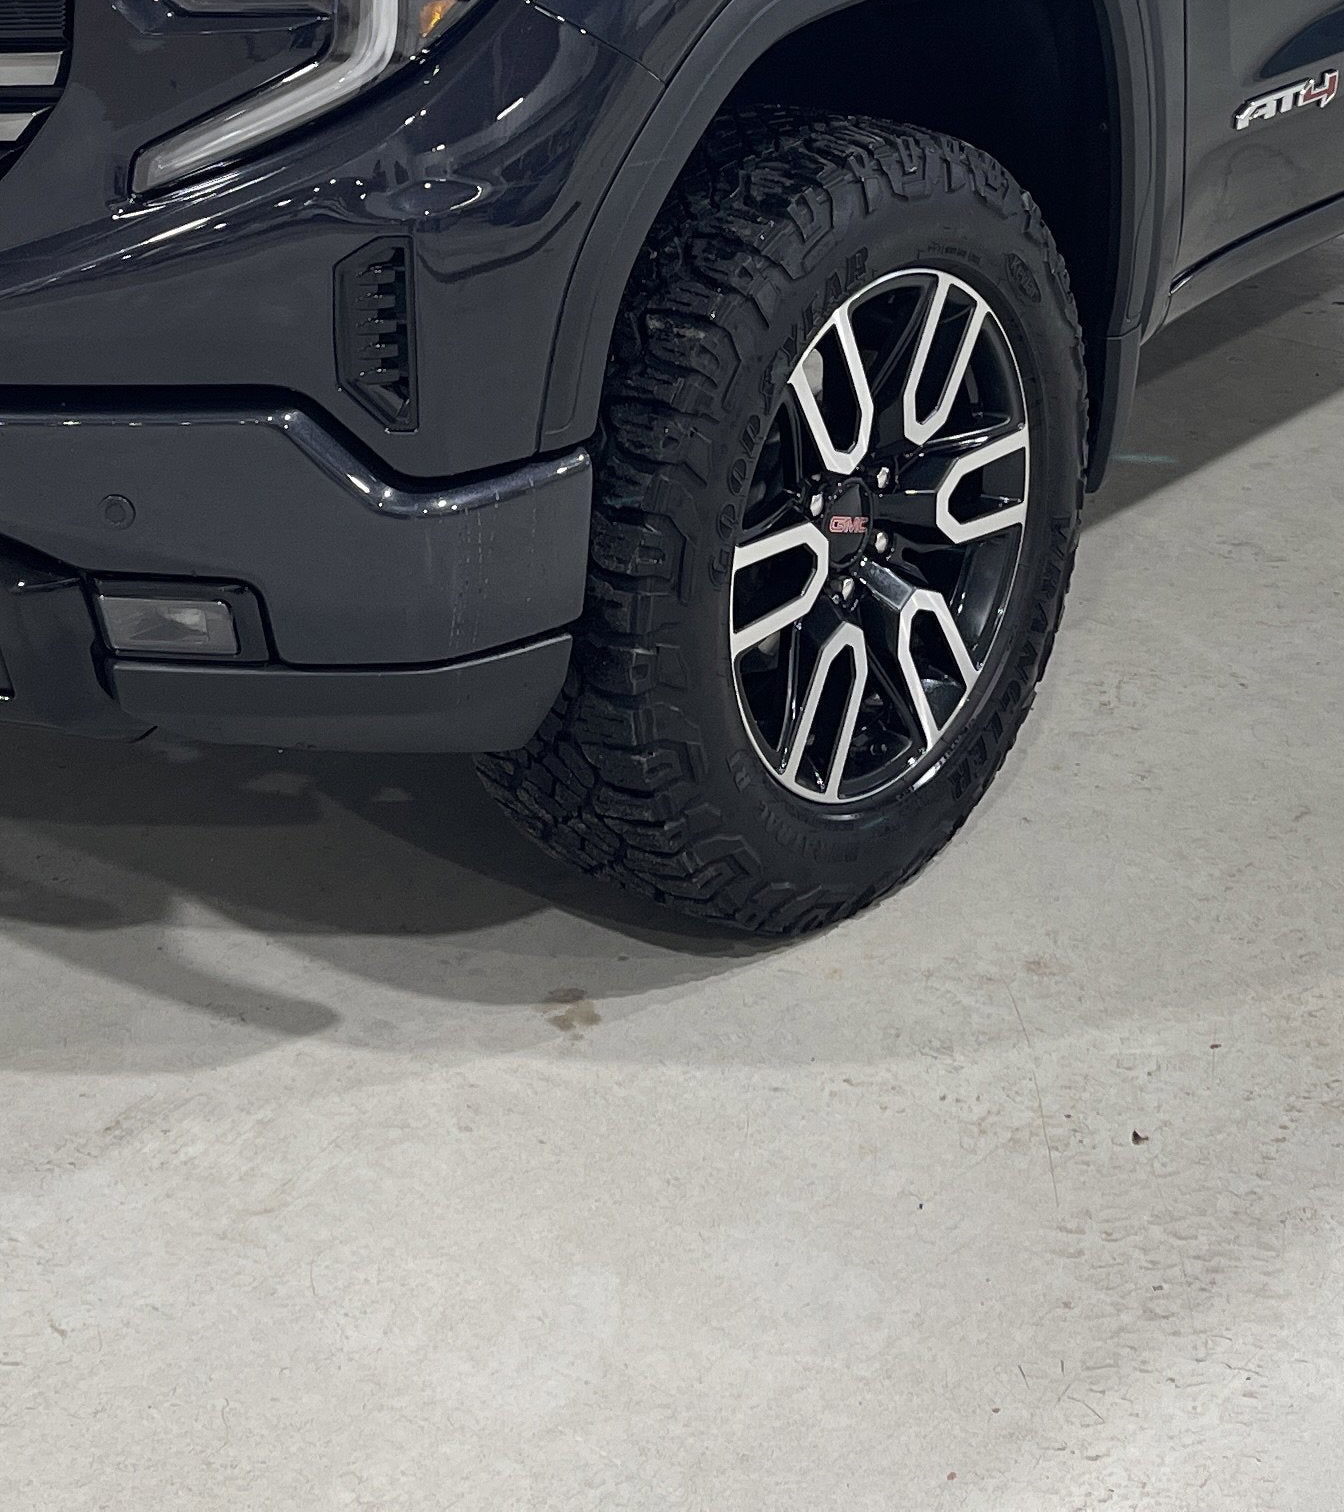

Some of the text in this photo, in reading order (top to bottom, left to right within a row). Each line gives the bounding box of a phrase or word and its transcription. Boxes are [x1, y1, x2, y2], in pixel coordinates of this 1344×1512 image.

[1232, 68, 1340, 131] AT4
[829, 515, 869, 534] GMC
[947, 515, 1071, 801] WRANGLER
